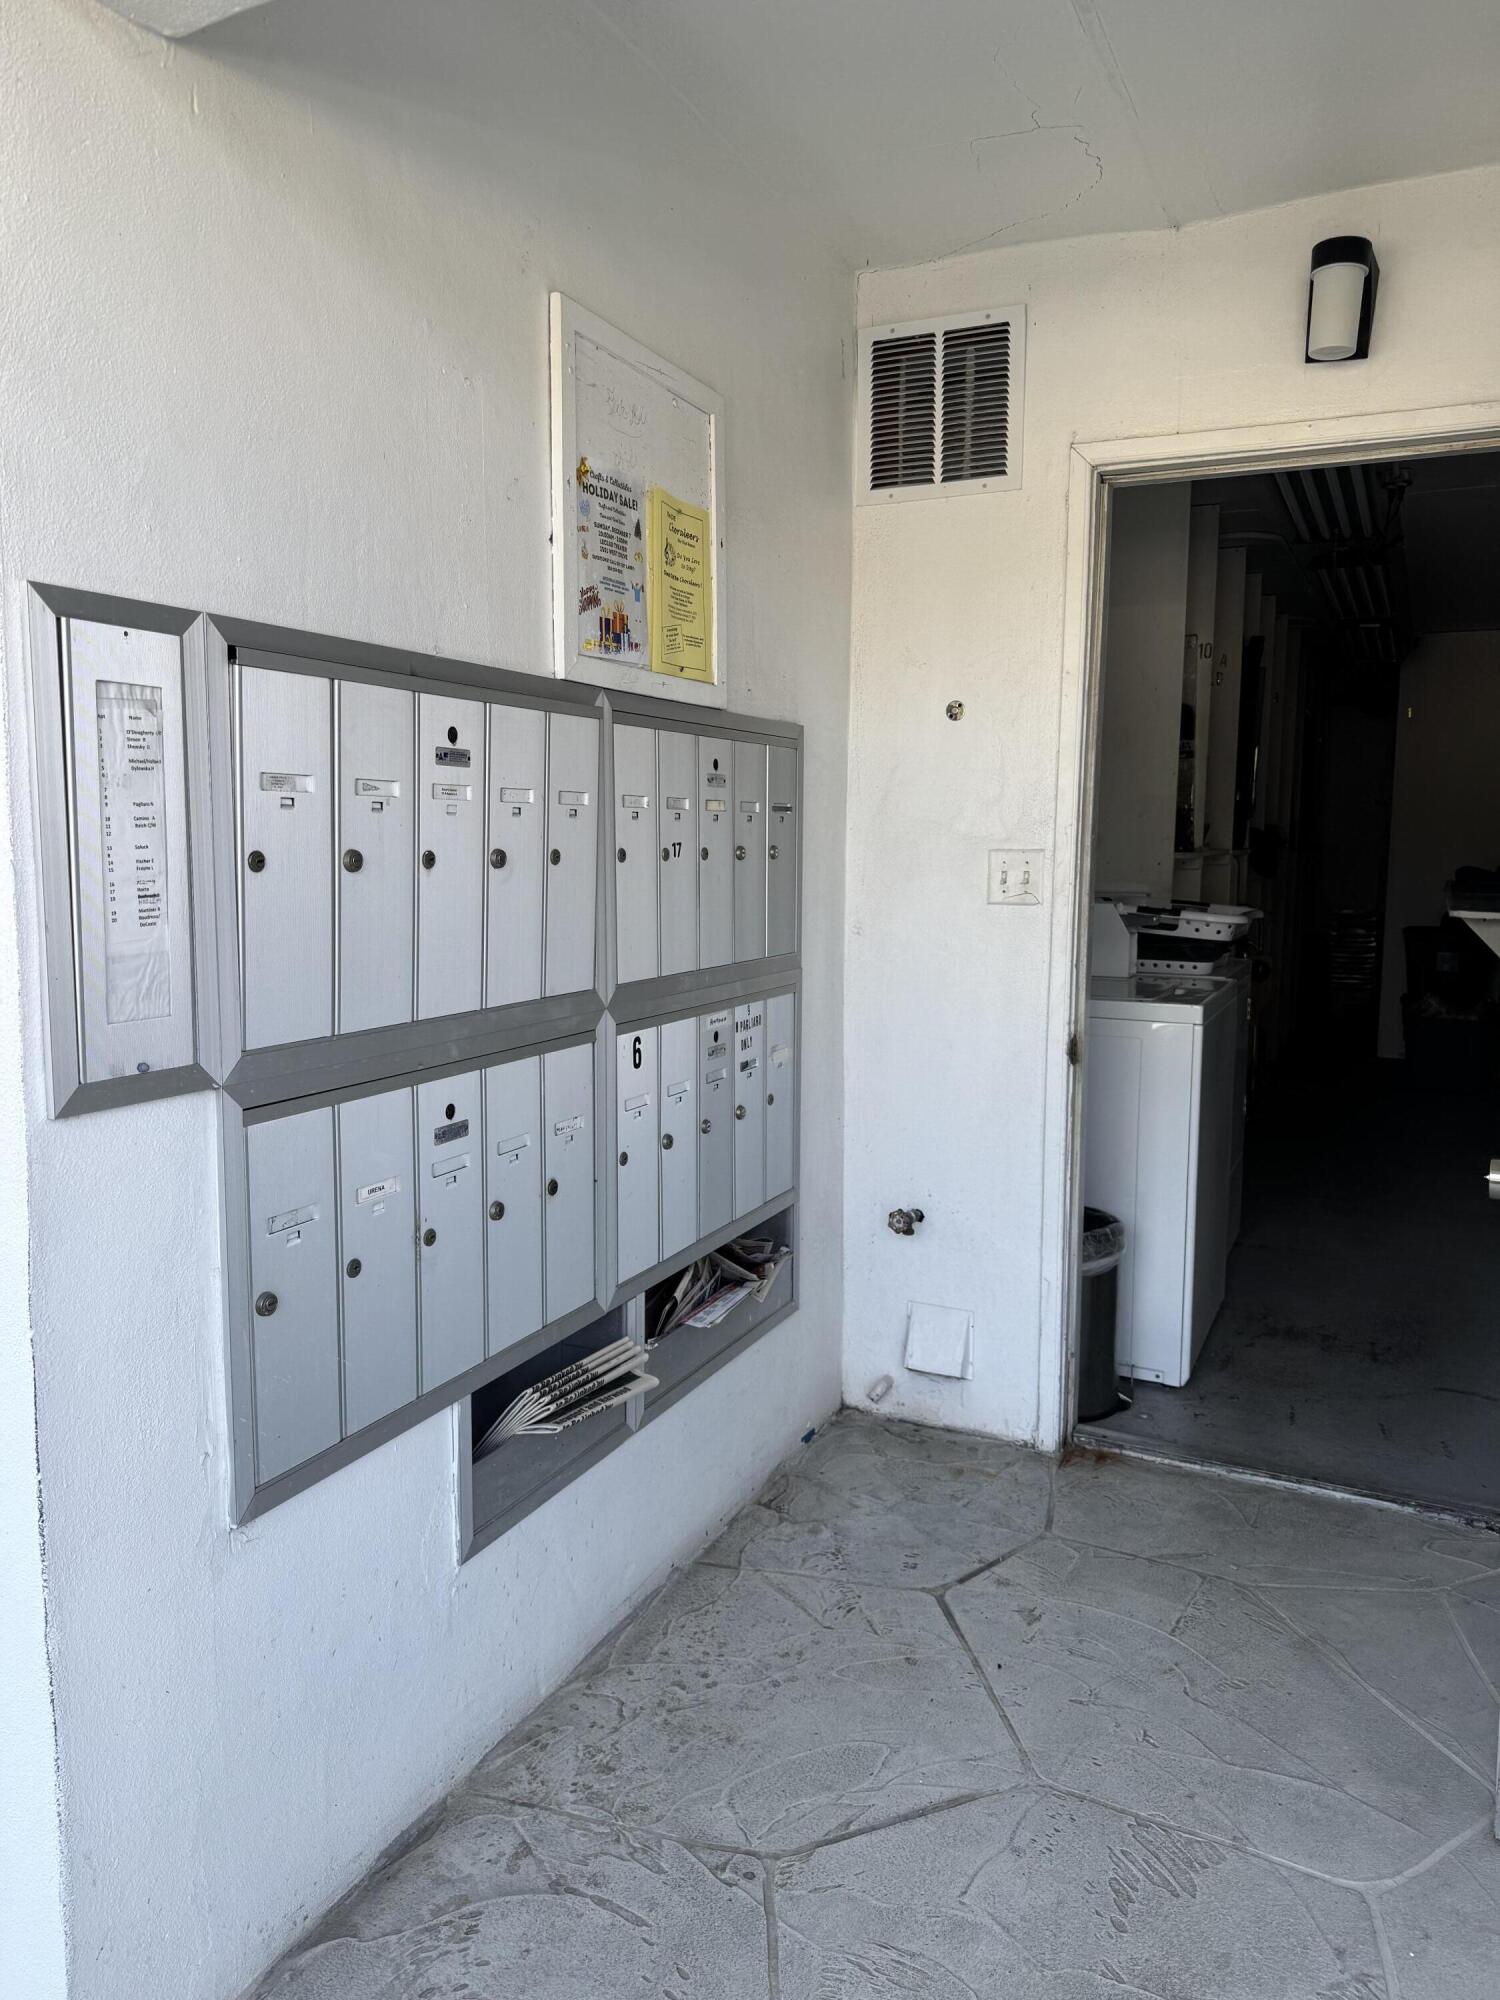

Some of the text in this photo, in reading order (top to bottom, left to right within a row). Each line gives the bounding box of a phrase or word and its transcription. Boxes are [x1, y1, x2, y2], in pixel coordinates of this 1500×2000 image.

[582, 481, 638, 511] HOLIDAY SALE!
[1199, 642, 1212, 659] 10
[671, 842, 682, 858] 17
[740, 1036, 753, 1052] ONLY
[632, 1035, 642, 1070] 6
[367, 1185, 385, 1195] URENA
